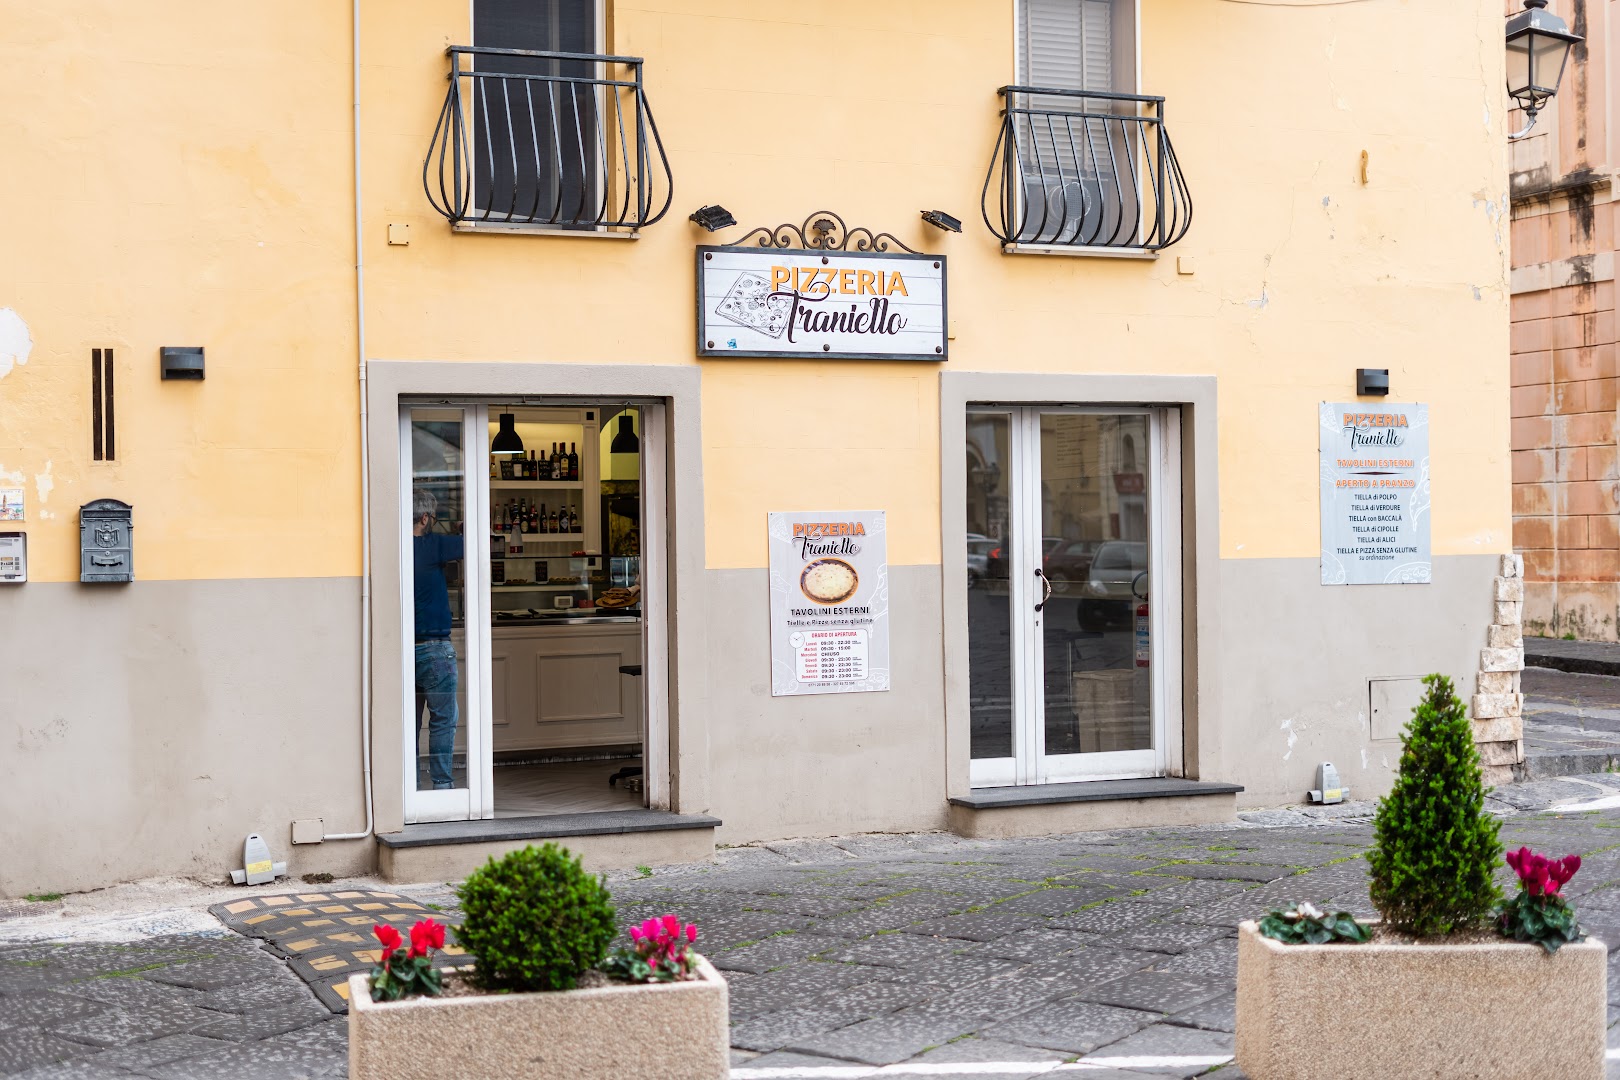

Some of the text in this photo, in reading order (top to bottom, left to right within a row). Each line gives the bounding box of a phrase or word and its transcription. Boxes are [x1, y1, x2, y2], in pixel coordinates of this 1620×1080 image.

[771, 266, 908, 297] PIZZERIA
[766, 282, 908, 344] Traniello
[1343, 414, 1408, 427] PIZZERIA
[1336, 460, 1377, 468] TAVOLINI
[793, 522, 865, 536] PIZZERIA
[791, 607, 870, 616] TAVOLINI ESTERNI
